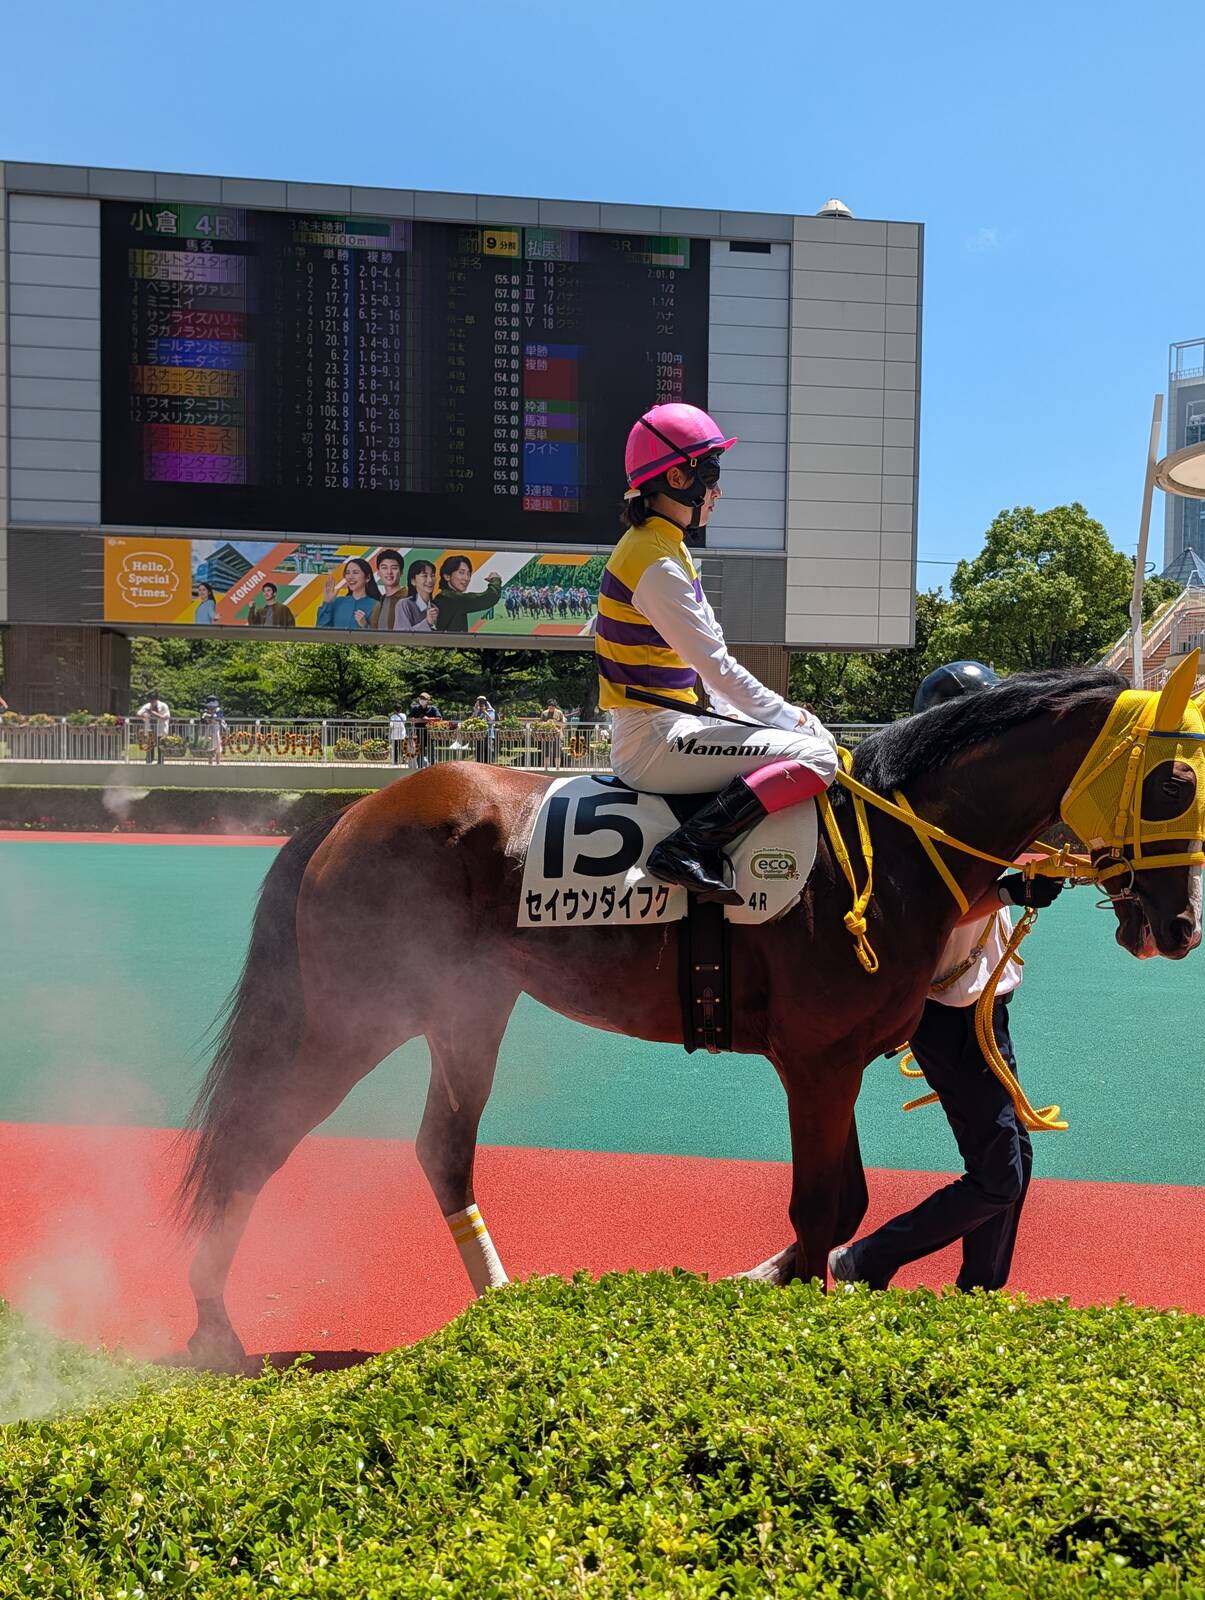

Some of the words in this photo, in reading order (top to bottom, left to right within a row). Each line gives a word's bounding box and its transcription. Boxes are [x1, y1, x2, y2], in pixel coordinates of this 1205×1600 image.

[130, 209, 177, 233] 小倉
[195, 215, 234, 236] 4R
[321, 234, 367, 245] 1700m
[486, 237, 496, 249] 9
[186, 239, 214, 252] 馬名
[322, 248, 349, 261] 単勝
[331, 264, 349, 275] 6.5
[359, 266, 400, 278] 2.0-4.4
[544, 262, 554, 273] 10
[331, 278, 349, 289] 2.1
[359, 280, 400, 292] 1.1-1.1
[495, 275, 520, 285] (55.0)
[544, 276, 554, 287] 14
[495, 289, 519, 299] (57.0)
[660, 284, 674, 293] 1/2
[326, 292, 349, 303] 17.7
[359, 294, 400, 307] 3.5-8.3
[548, 290, 554, 301] 7
[325, 306, 349, 317] 57.4
[495, 303, 519, 313] (57.0)
[544, 304, 554, 315] 16
[320, 320, 349, 332] 121.8
[495, 317, 519, 327] (55.0)
[543, 318, 554, 329] 18
[495, 331, 519, 341] (57.0)
[325, 335, 349, 346] 20.1
[359, 336, 400, 349] 3.4-8.0
[494, 345, 519, 355] (57.0)
[331, 349, 349, 360] 6.2
[359, 350, 400, 363] 1.6-3.0
[494, 359, 519, 369] (57.0)
[325, 363, 349, 374] 23.3
[359, 364, 400, 377] 3.9-9.3
[656, 365, 682, 377] 370円
[325, 377, 349, 388] 46.3
[494, 373, 519, 383] (54.0)
[656, 379, 682, 391] 320円
[494, 387, 519, 397] (57.0)
[325, 392, 349, 403] 33.0
[359, 393, 400, 405] 4.0-9.7
[320, 406, 349, 417] 106.8
[494, 401, 519, 411] (55.0)
[325, 420, 349, 431] 24.3
[494, 415, 519, 425] (55.0)
[325, 434, 349, 445] 91.6
[494, 429, 519, 439] (57.0)
[494, 443, 519, 453] (55.0)
[525, 443, 559, 455] ワイド
[326, 448, 349, 459] 12.8
[359, 449, 400, 462] 2.9-6.8
[494, 457, 519, 467] (57.0)
[326, 462, 349, 474] 12.6
[359, 463, 400, 476] 2.6-6.1
[494, 471, 519, 481] (55.0)
[325, 477, 349, 488] 52.8
[494, 485, 519, 495] (55.0)
[132, 561, 166, 573] Hello,
[128, 573, 169, 585] Special
[130, 587, 169, 598] Times.
[230, 570, 267, 605] KOKURA
[221, 731, 323, 756] KOKURA
[670, 736, 770, 756] Manami
[543, 791, 643, 878] 15
[1111, 848, 1120, 858] 15
[758, 859, 788, 870] eco
[526, 885, 669, 922] セイウンダイフク
[749, 892, 767, 911] 4R
